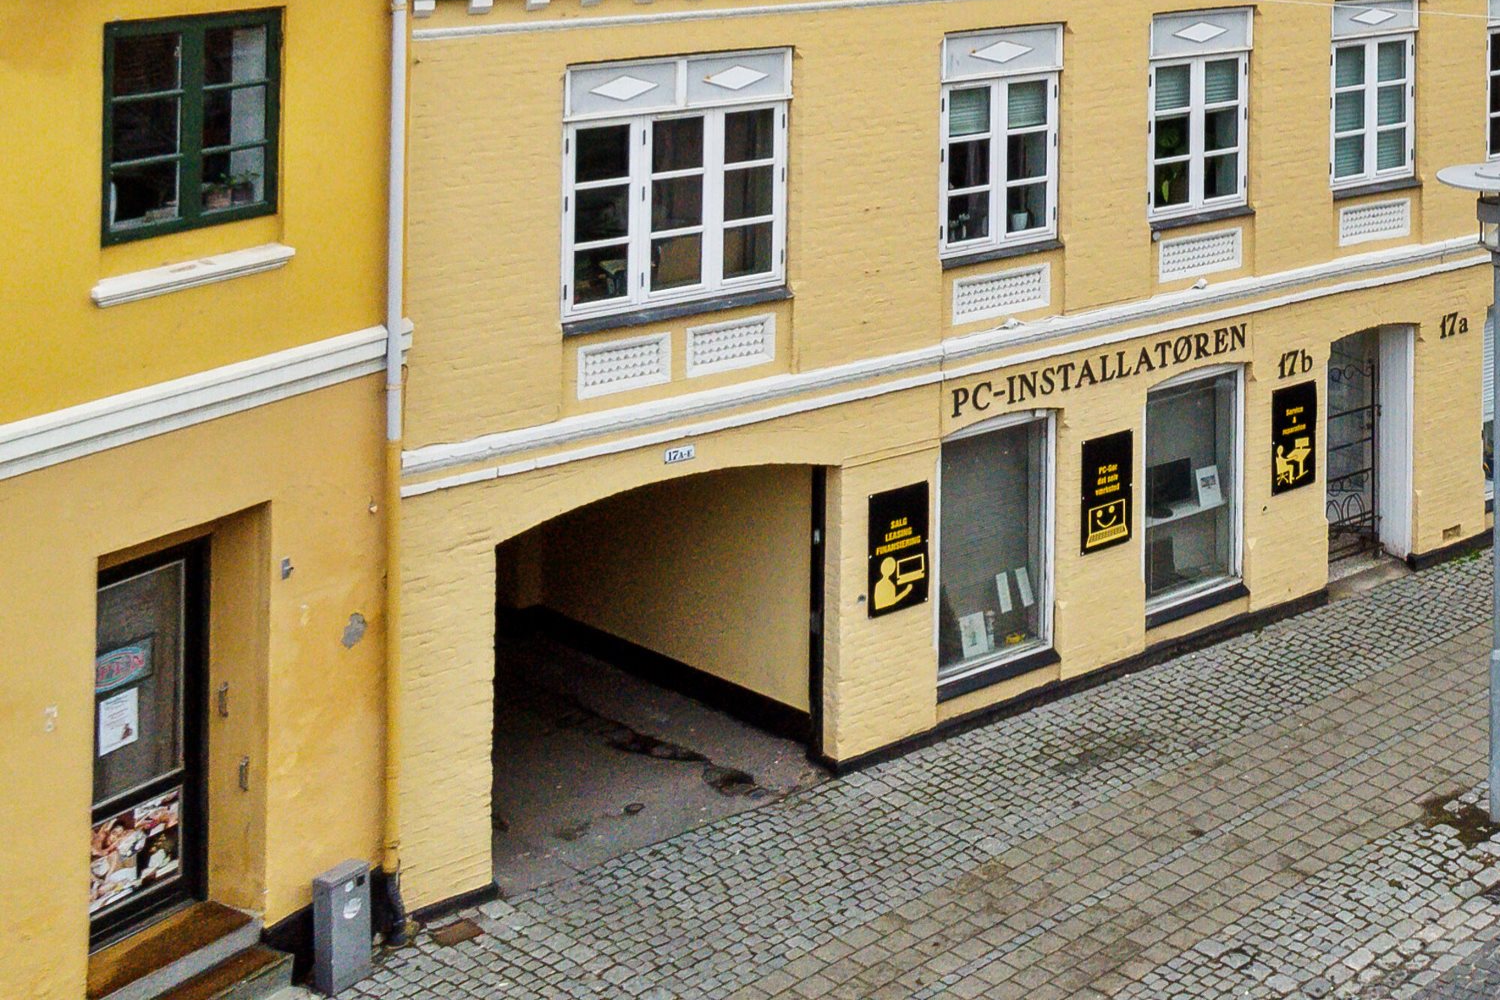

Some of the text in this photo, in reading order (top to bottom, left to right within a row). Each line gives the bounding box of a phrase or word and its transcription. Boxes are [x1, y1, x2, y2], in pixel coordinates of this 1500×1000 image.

[1439, 312, 1469, 339] 17a
[951, 323, 1248, 418] PC-INSTALLATØREN
[1278, 349, 1313, 379] 17b
[885, 526, 912, 542] LEASING
[890, 516, 908, 529] SALG
